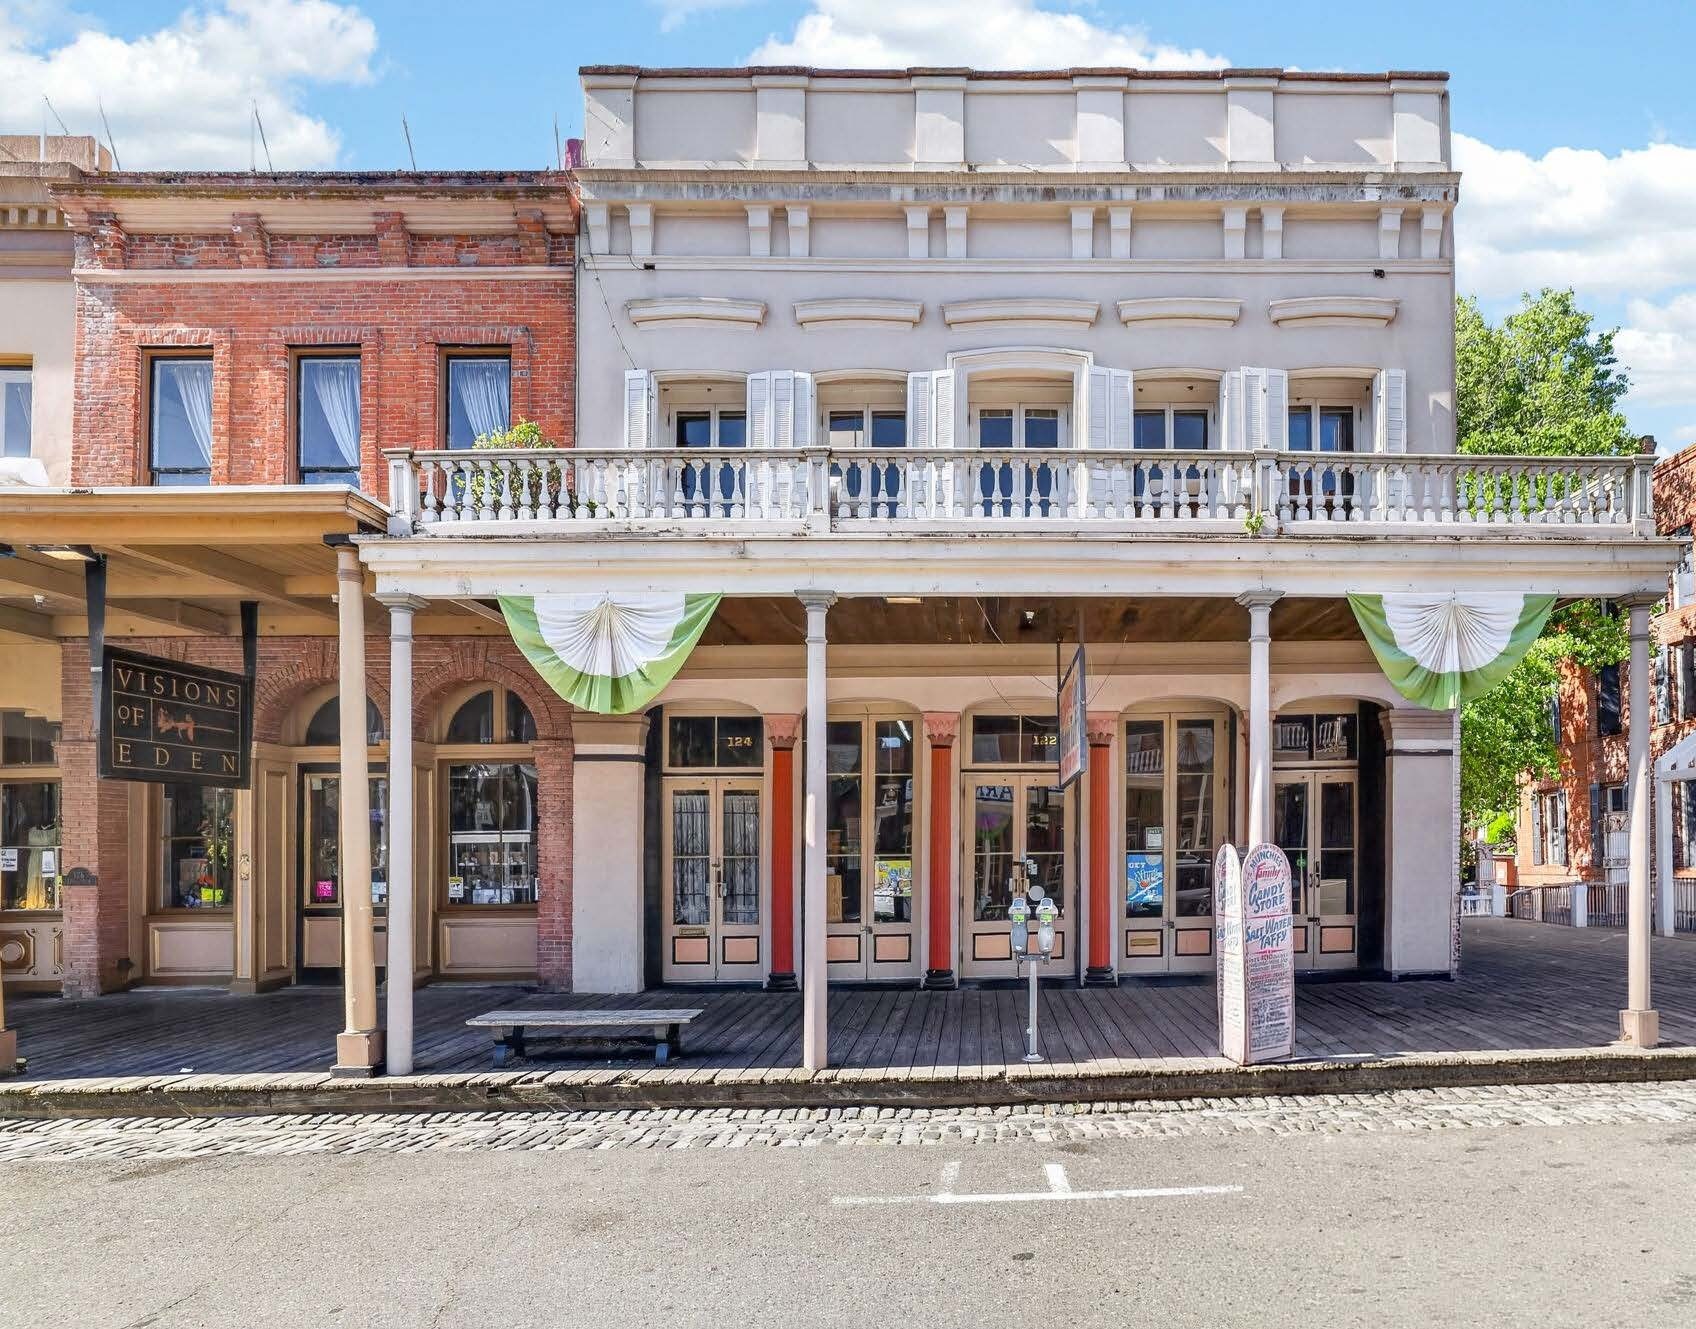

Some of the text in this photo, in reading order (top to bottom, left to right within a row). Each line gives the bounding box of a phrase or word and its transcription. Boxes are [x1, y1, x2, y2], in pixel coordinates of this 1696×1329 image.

[116, 668, 236, 707] VISIONS
[117, 705, 145, 727] OF
[727, 736, 753, 747] 124
[1033, 735, 1057, 745] 122
[117, 743, 236, 773] EDEN
[1249, 850, 1283, 870] MUNCHIES
[1255, 862, 1281, 881] Family
[1248, 882, 1285, 907] CANDY
[1253, 893, 1285, 914] STORE
[1245, 925, 1265, 943] SALT
[1259, 929, 1287, 950] TAFFY
